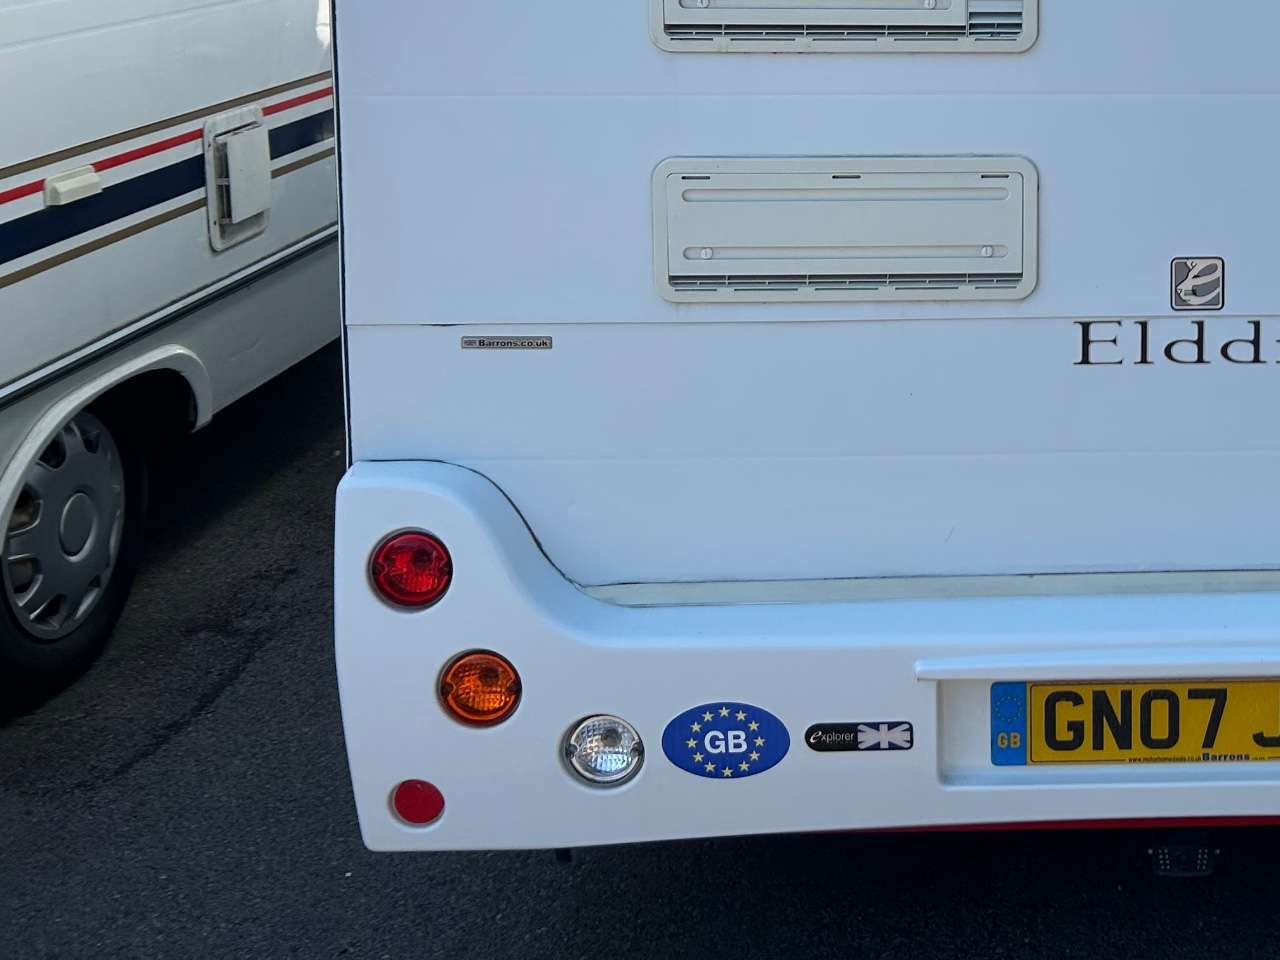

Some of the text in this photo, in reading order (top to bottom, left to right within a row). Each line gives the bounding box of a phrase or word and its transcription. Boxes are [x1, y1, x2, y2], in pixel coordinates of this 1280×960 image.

[478, 339, 548, 348] Barrons.co.uk
[1044, 687, 1229, 751] GN07
[703, 730, 748, 754] GB
[809, 730, 855, 743] explorer
[997, 732, 1021, 749] GB
[1202, 752, 1251, 761] Barrons
